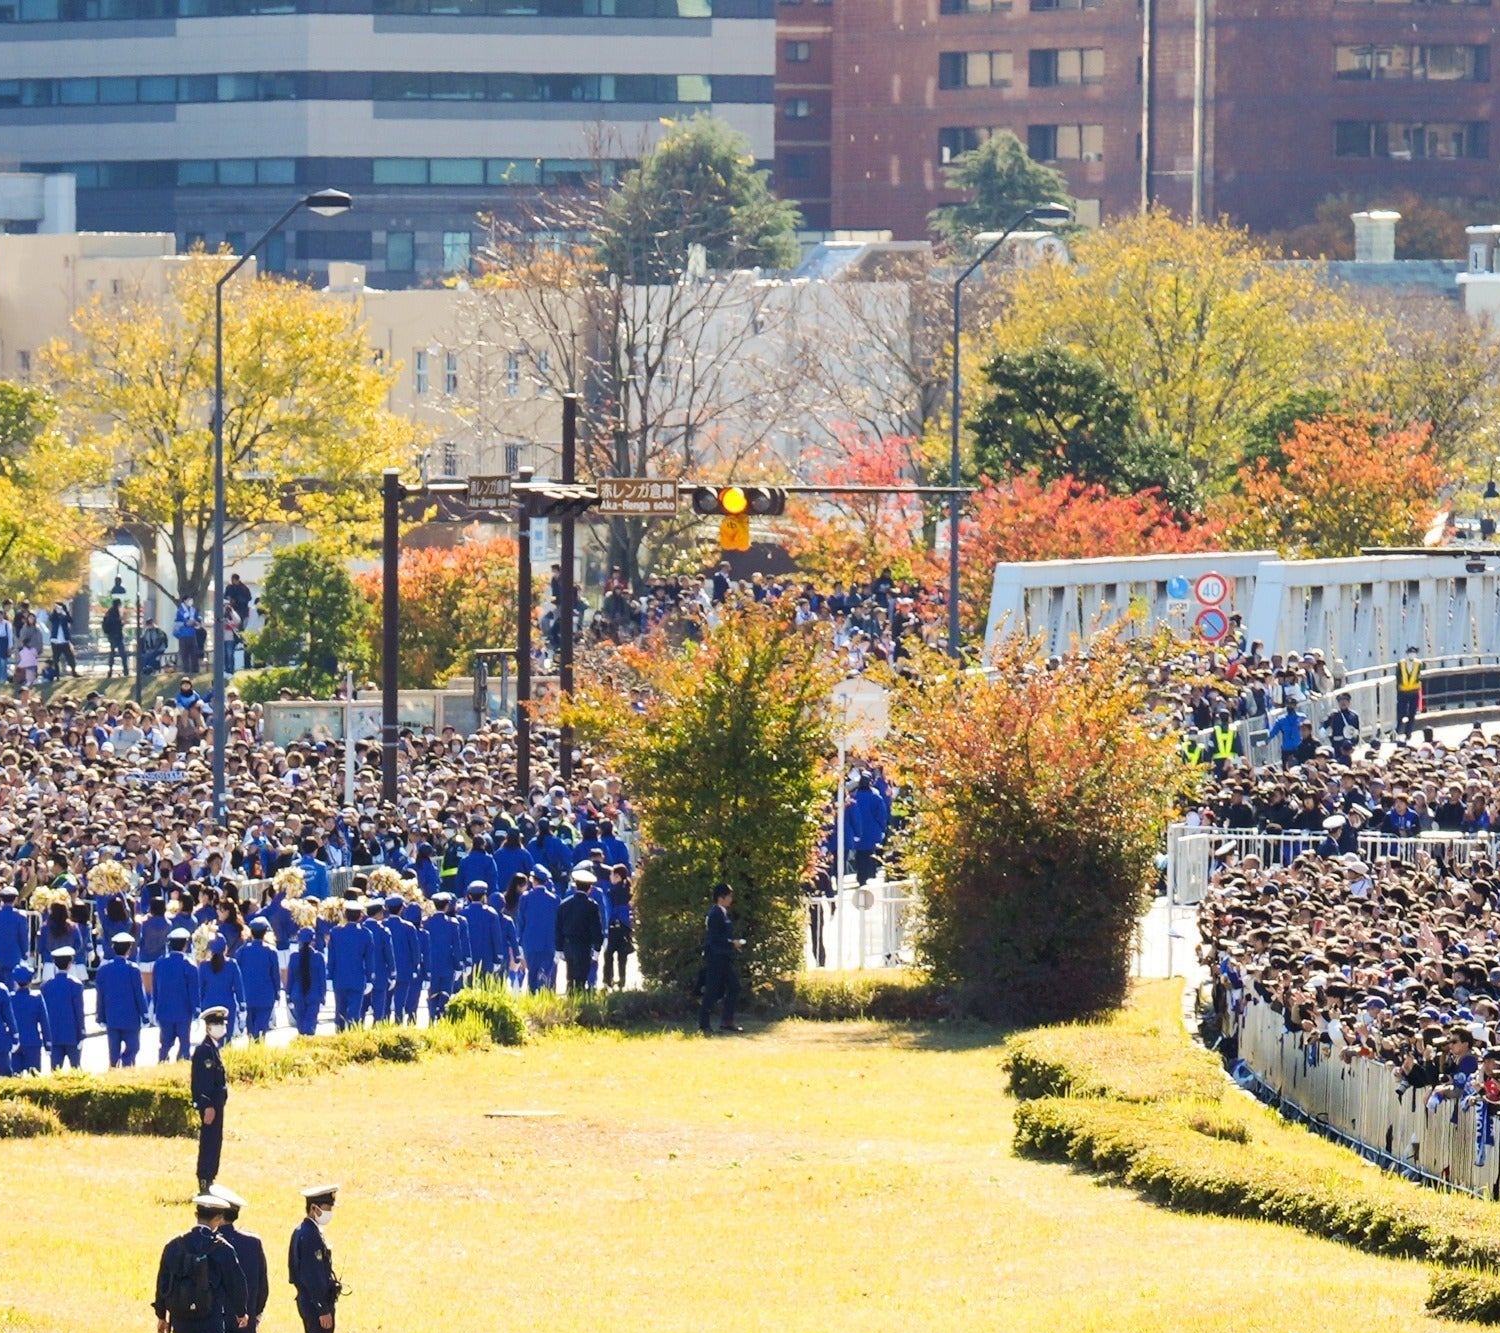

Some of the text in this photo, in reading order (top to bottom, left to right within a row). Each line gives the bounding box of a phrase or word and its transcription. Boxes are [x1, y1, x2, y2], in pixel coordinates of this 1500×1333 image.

[600, 484, 675, 500] 赤レンガ倉庫
[600, 500, 676, 512] Aka-Renga soko
[1202, 582, 1221, 598] 40
